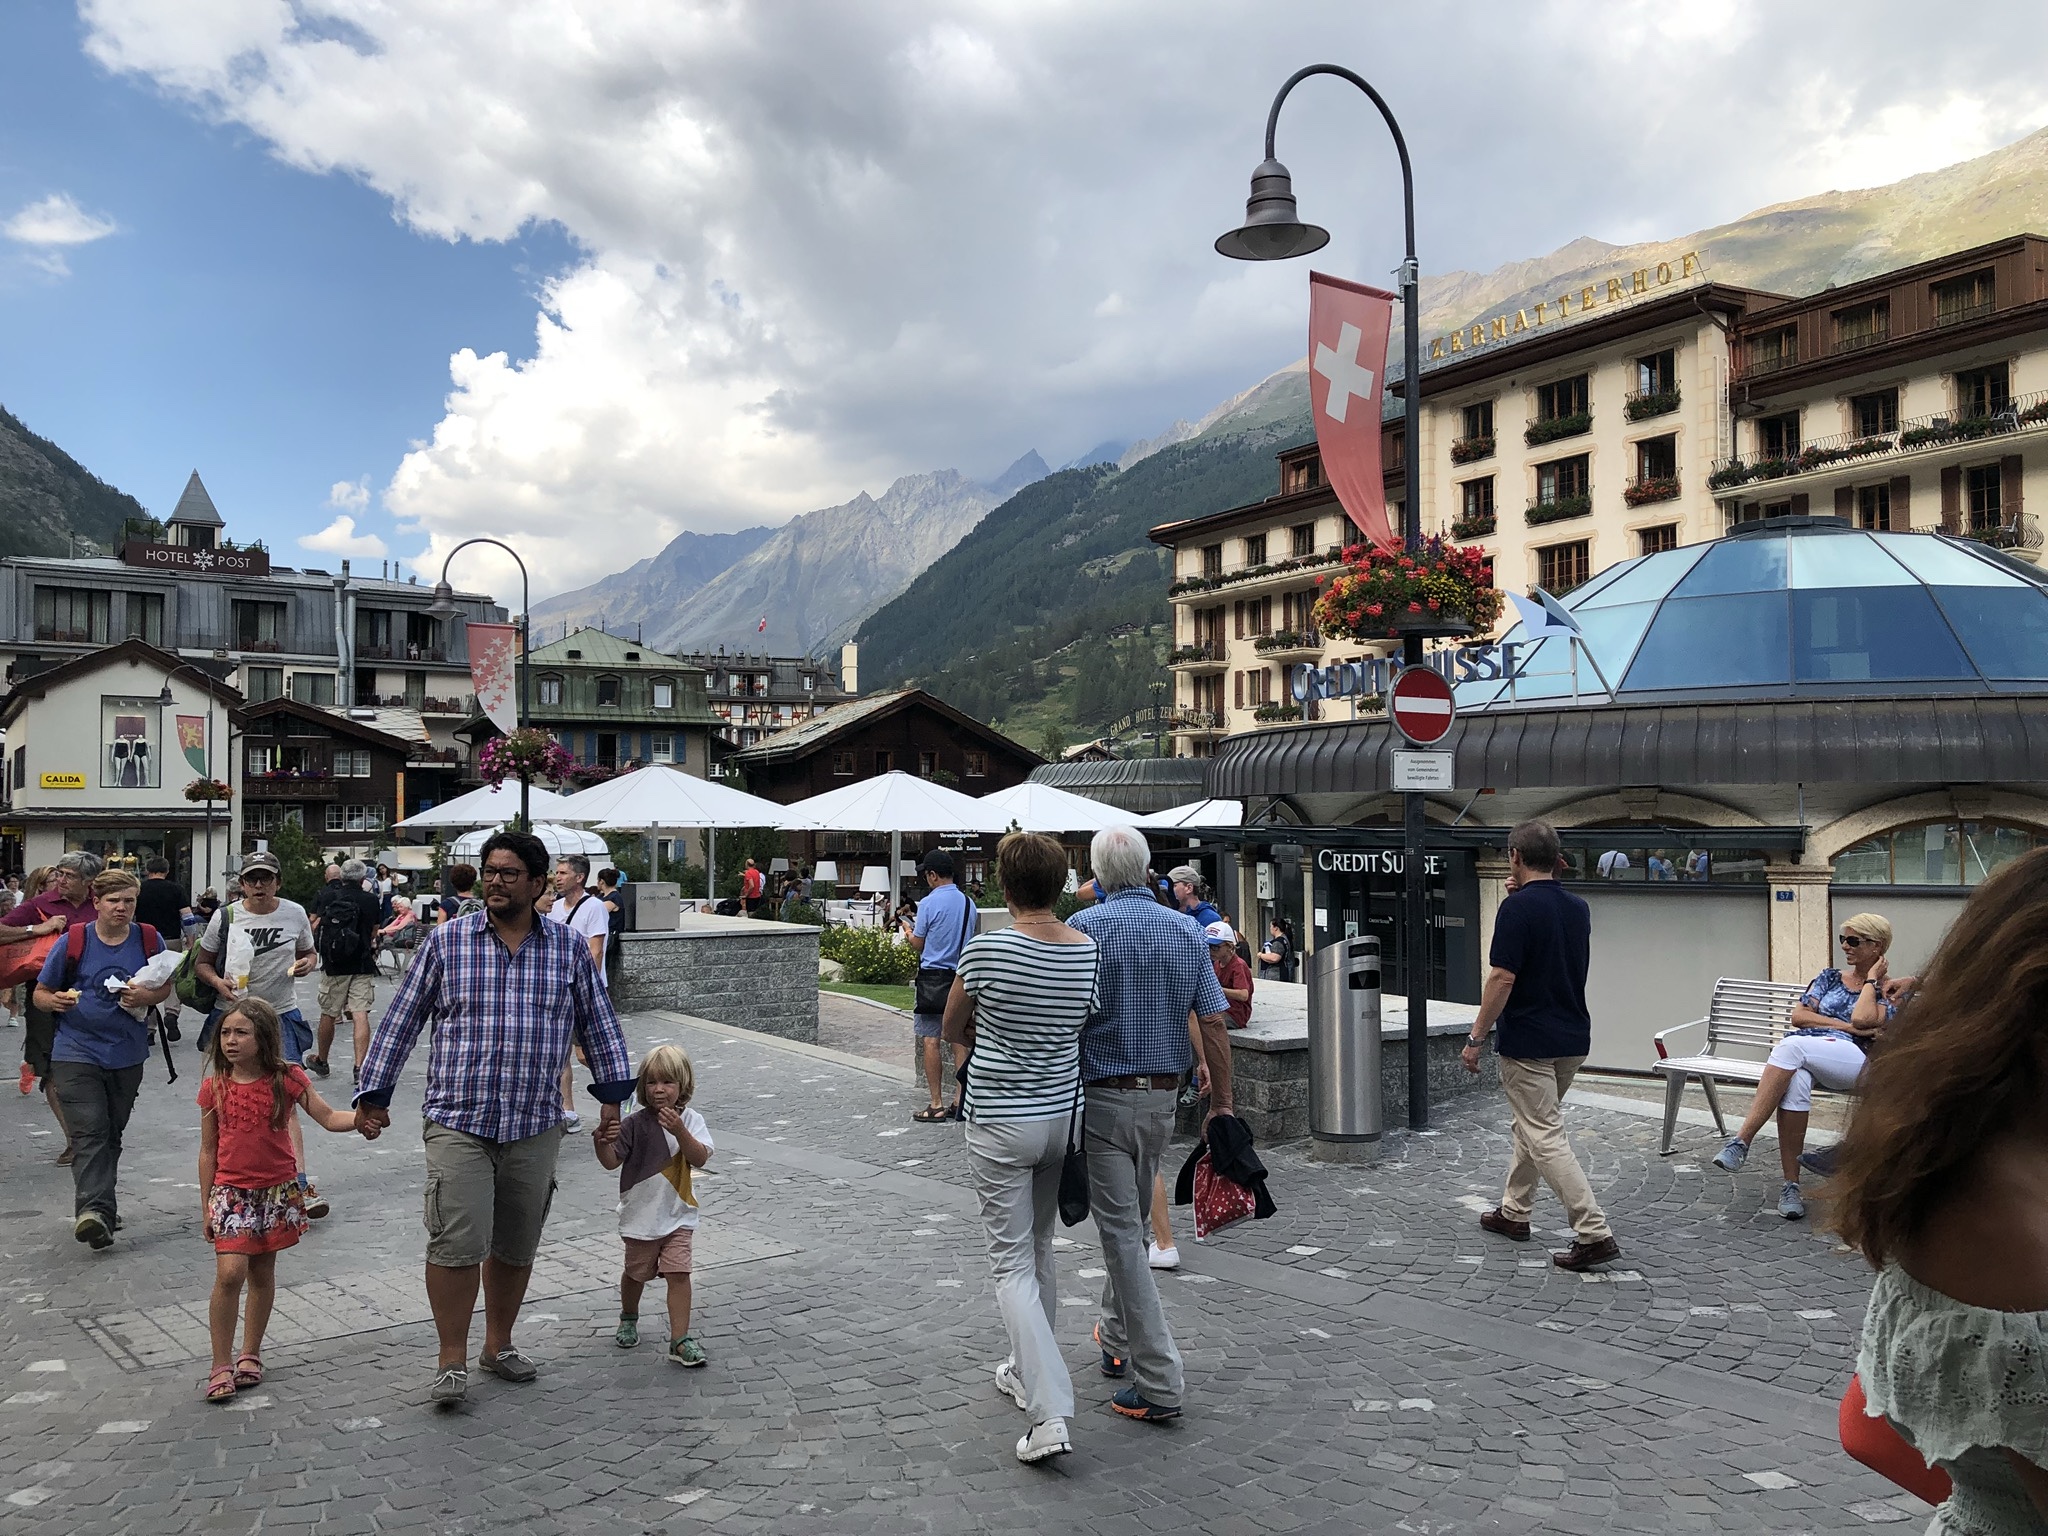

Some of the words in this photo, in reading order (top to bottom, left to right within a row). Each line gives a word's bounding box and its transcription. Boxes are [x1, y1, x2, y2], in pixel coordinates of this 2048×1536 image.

[1431, 251, 1701, 361] ZERMATTERHOF
[145, 549, 190, 564] HOTEL
[217, 555, 251, 569] POST
[1291, 657, 1392, 702] CREDIT
[1110, 715, 1131, 736] GRAND
[1135, 707, 1155, 724] HOTEL
[45, 775, 81, 783] CALIDA
[1318, 849, 1379, 873] CREDIT
[1381, 850, 1440, 875] SUSE
[1780, 892, 1790, 900] 57
